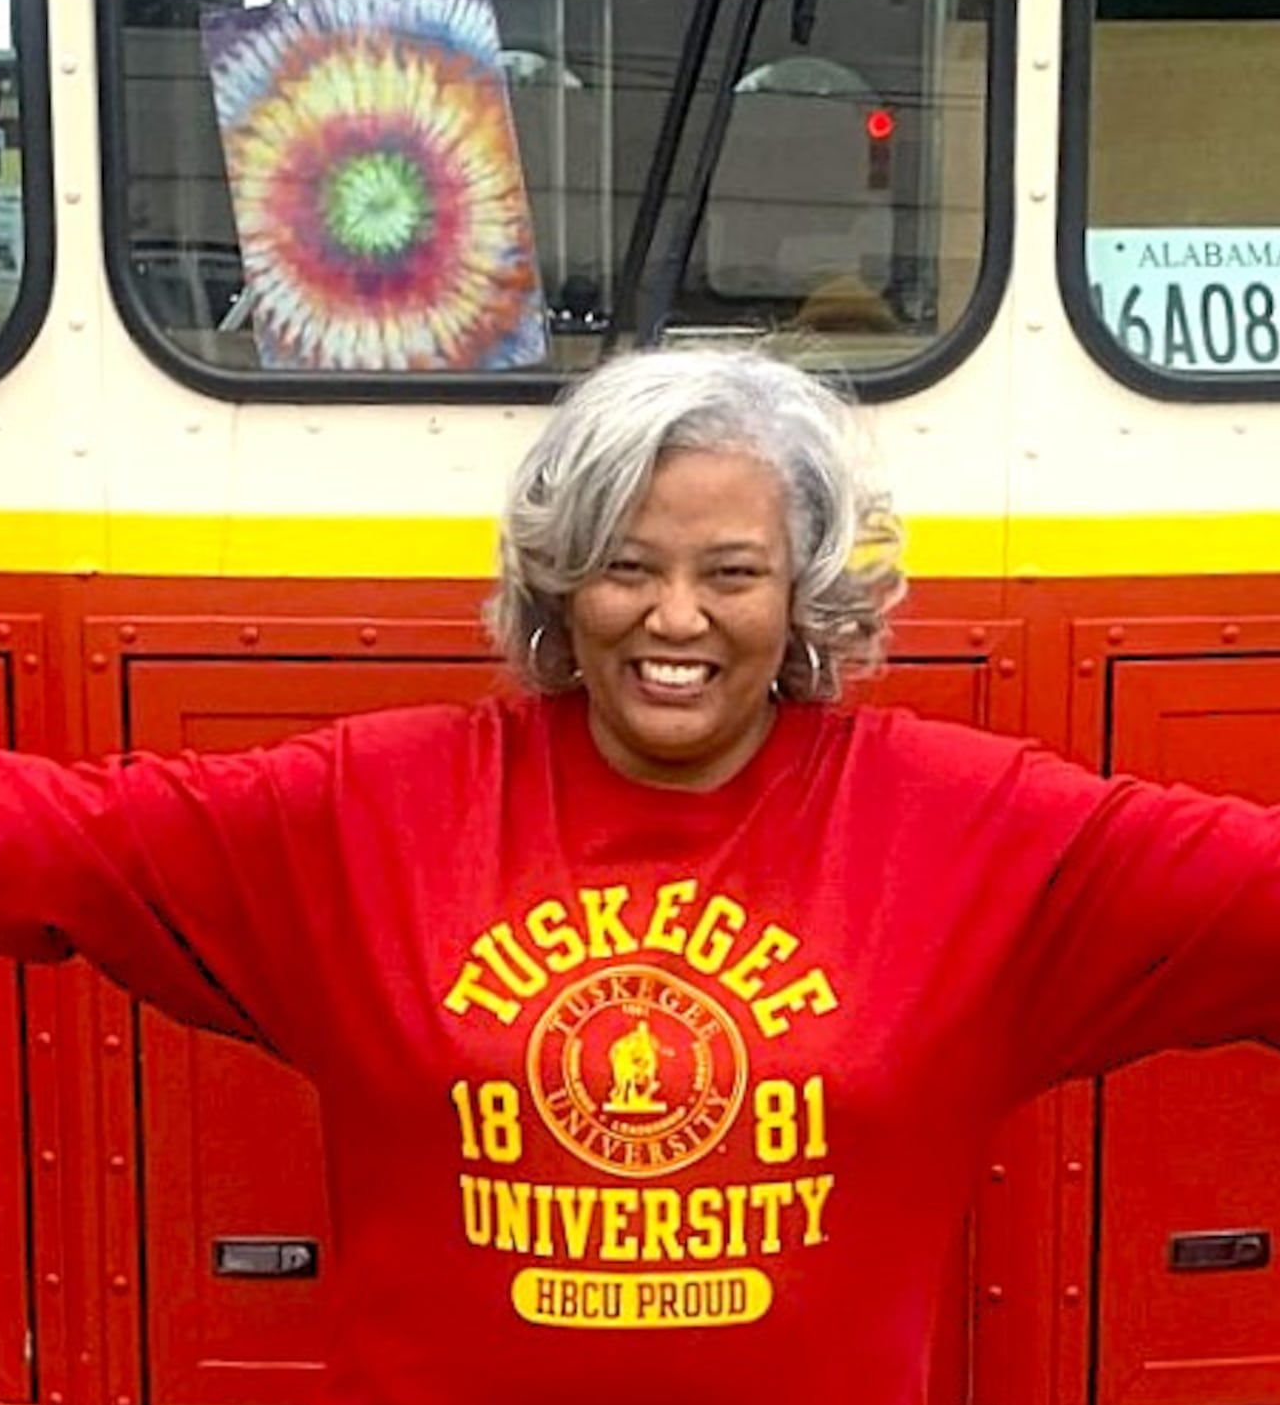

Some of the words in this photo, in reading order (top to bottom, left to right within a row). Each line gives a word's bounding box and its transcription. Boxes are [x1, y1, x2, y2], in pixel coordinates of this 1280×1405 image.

[443, 878, 839, 1039] TUSKEGEE
[547, 976, 721, 1041] TUSKEGEE
[450, 1079, 523, 1163] 18
[546, 1086, 731, 1167] UNIVERSITY
[754, 1076, 828, 1163] 81
[459, 1173, 835, 1261] UNIVERSITY
[536, 1277, 622, 1319] HBCU
[636, 1276, 748, 1319] PROUD
